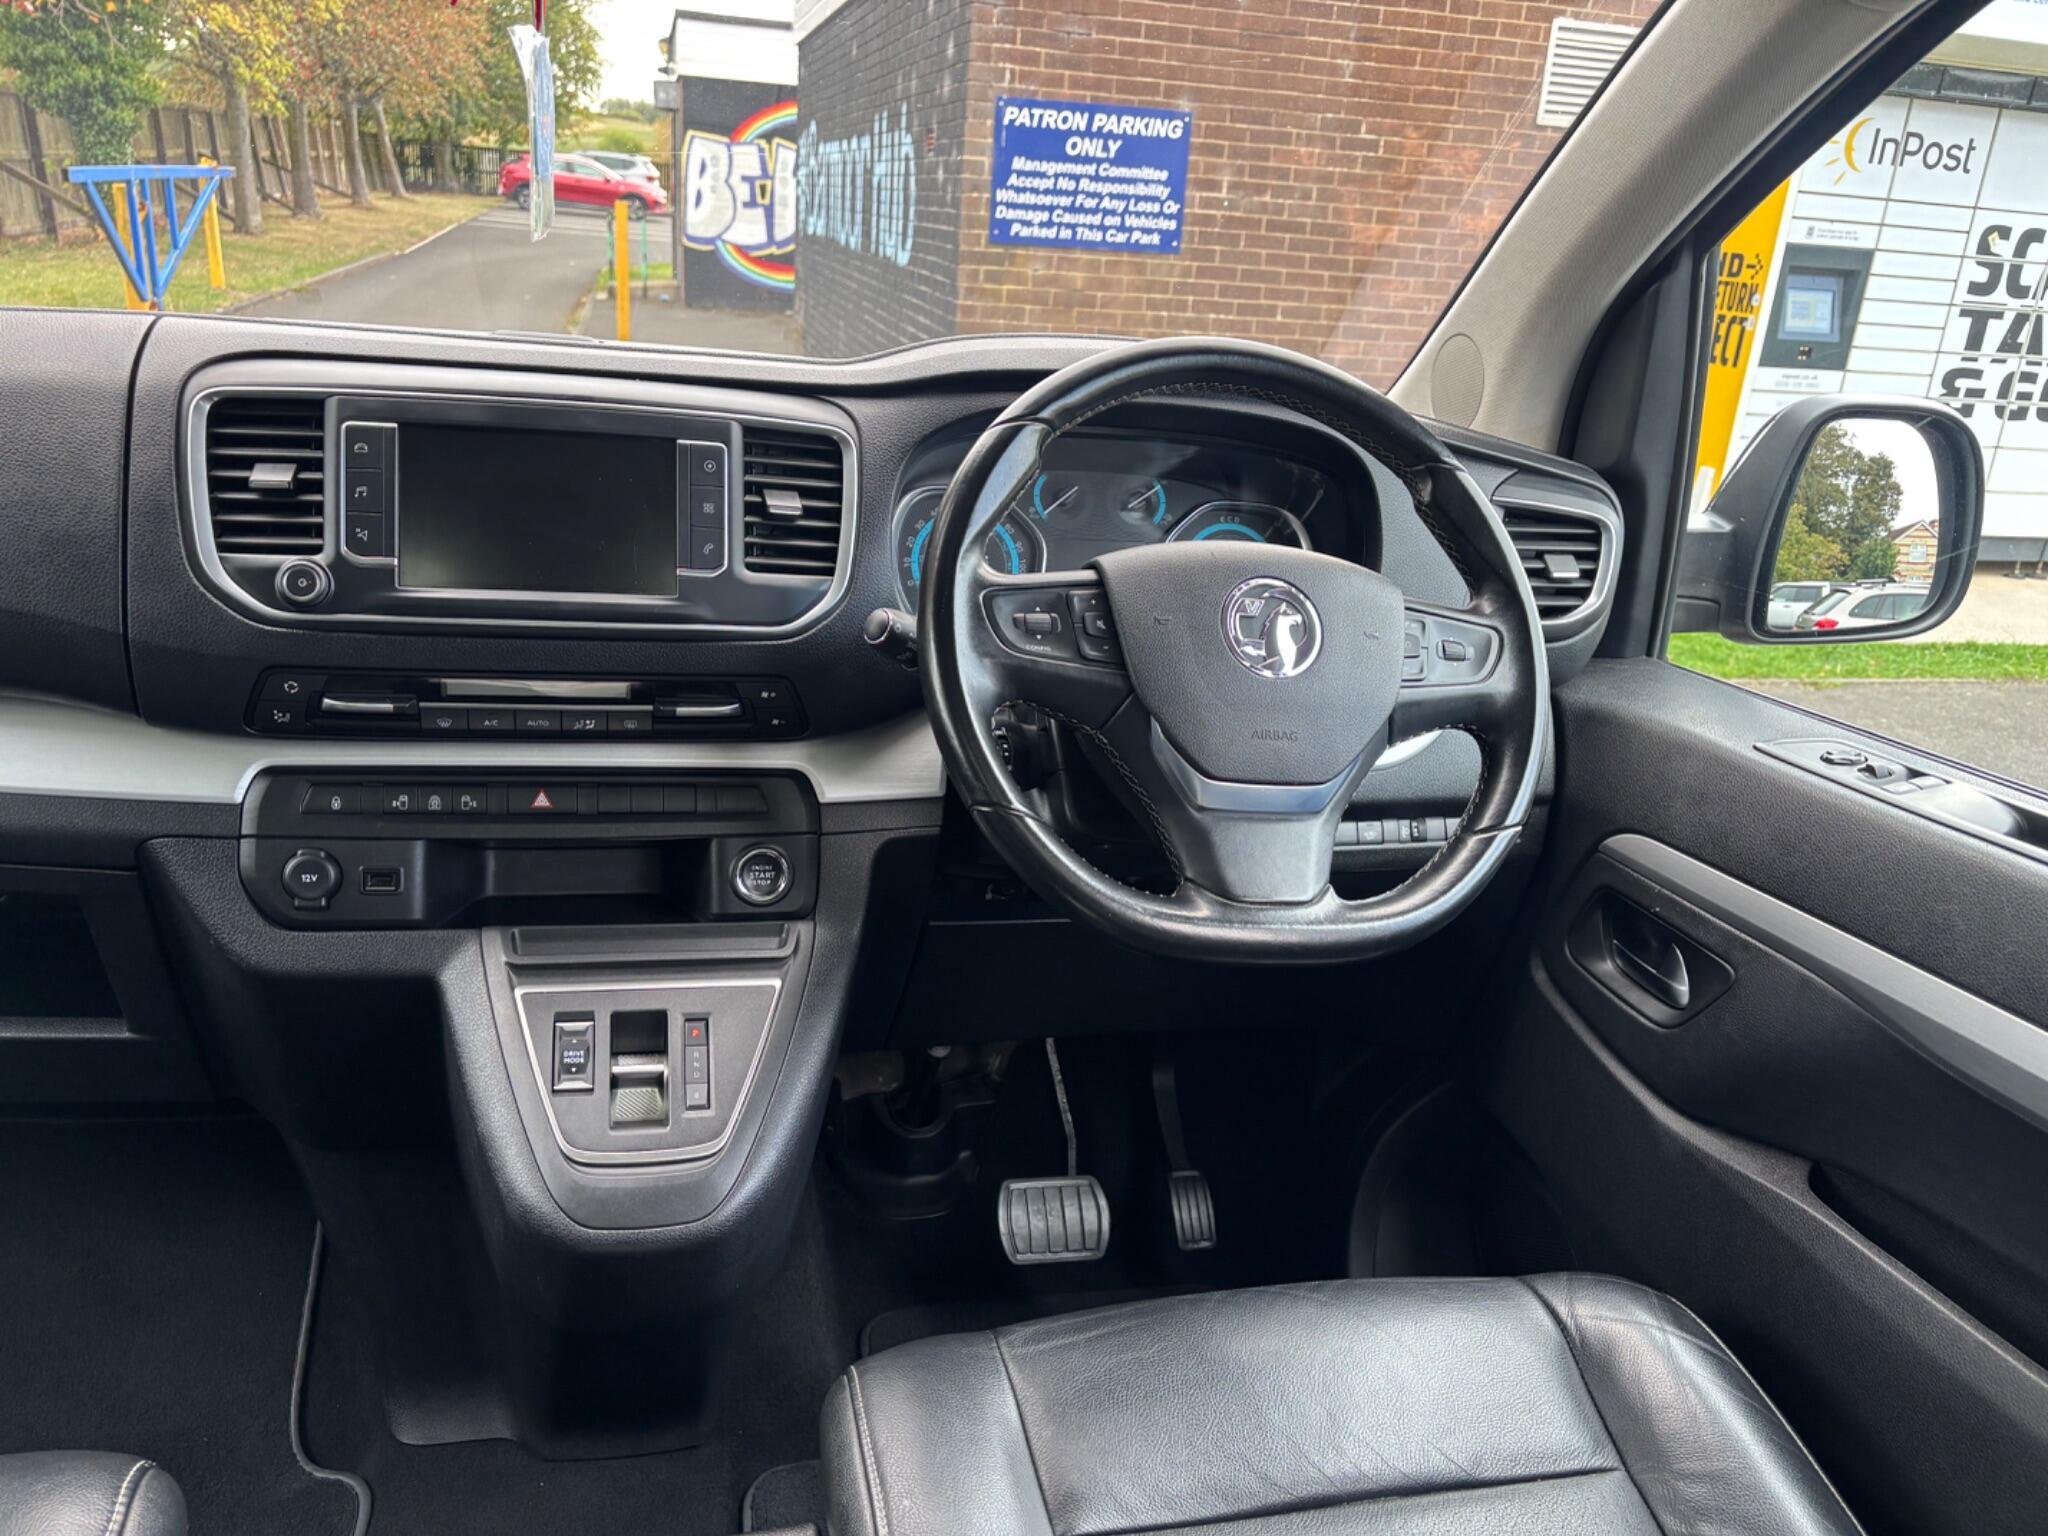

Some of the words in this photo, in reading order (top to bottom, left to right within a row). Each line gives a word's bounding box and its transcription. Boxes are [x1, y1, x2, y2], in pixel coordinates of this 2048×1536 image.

[1003, 106, 1089, 131] PATRON
[1091, 112, 1184, 139] PARKING
[1065, 136, 1123, 159] ONLY
[1868, 127, 1977, 174] InPost
[1011, 156, 1097, 176] Management
[1098, 162, 1169, 181] Committee
[1006, 173, 1055, 192] Accept
[1056, 176, 1077, 191] No
[1077, 178, 1172, 200] Responsibility
[996, 188, 1074, 207] Whatsoever
[1074, 193, 1100, 209] For
[1099, 195, 1128, 214] Any
[1128, 197, 1161, 213] Loss
[1162, 199, 1181, 215] Or
[994, 205, 1050, 225] Damage
[1051, 208, 1103, 226] Caused
[1103, 215, 1122, 228] on
[1124, 213, 1177, 231] Vehicles
[1009, 222, 1058, 240] Parked
[1058, 226, 1073, 240] in
[1075, 226, 1104, 242] This
[1105, 228, 1130, 243] Car
[1129, 229, 1161, 246] Park
[1719, 251, 1745, 279] D
[1715, 280, 1759, 314] TURN
[1994, 370, 2048, 423] G
[483, 719, 499, 727] A/C
[527, 719, 550, 727] AUTO
[1251, 727, 1299, 743] AIRBAG
[301, 873, 318, 883] 12V
[750, 871, 776, 879] START
[563, 1050, 585, 1058] DRIVE
